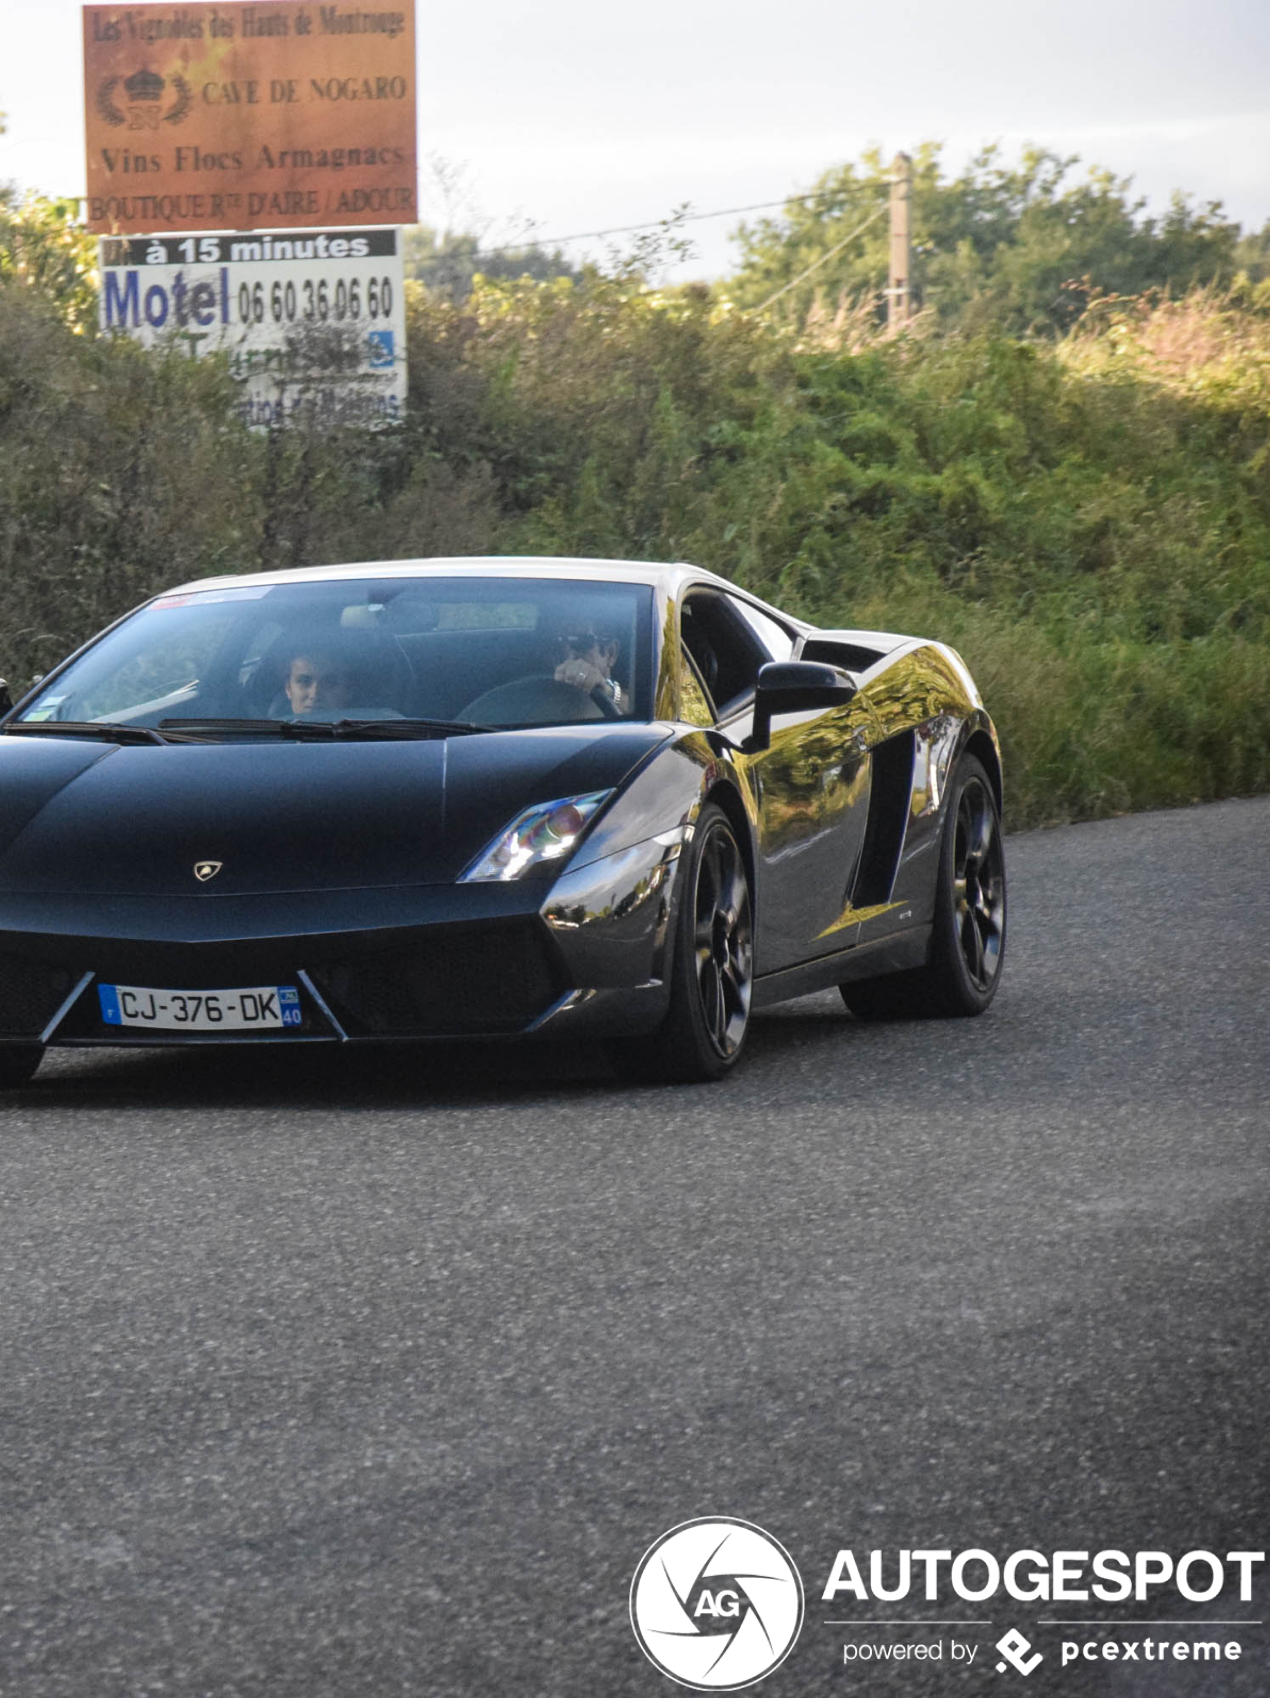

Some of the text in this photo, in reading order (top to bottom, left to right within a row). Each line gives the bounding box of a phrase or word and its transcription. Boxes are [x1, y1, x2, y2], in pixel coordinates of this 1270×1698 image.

[202, 75, 407, 105] CAVE DE NOGARO
[101, 144, 405, 174] Vins Flocs Armagnacs
[91, 194, 204, 224] BOUTIQUE
[335, 187, 415, 213] ADOUR
[146, 235, 369, 264] à 15 minutes
[104, 267, 228, 328] Motel
[121, 992, 279, 1022] CJ-376-DK
[283, 1009, 301, 1024] 40
